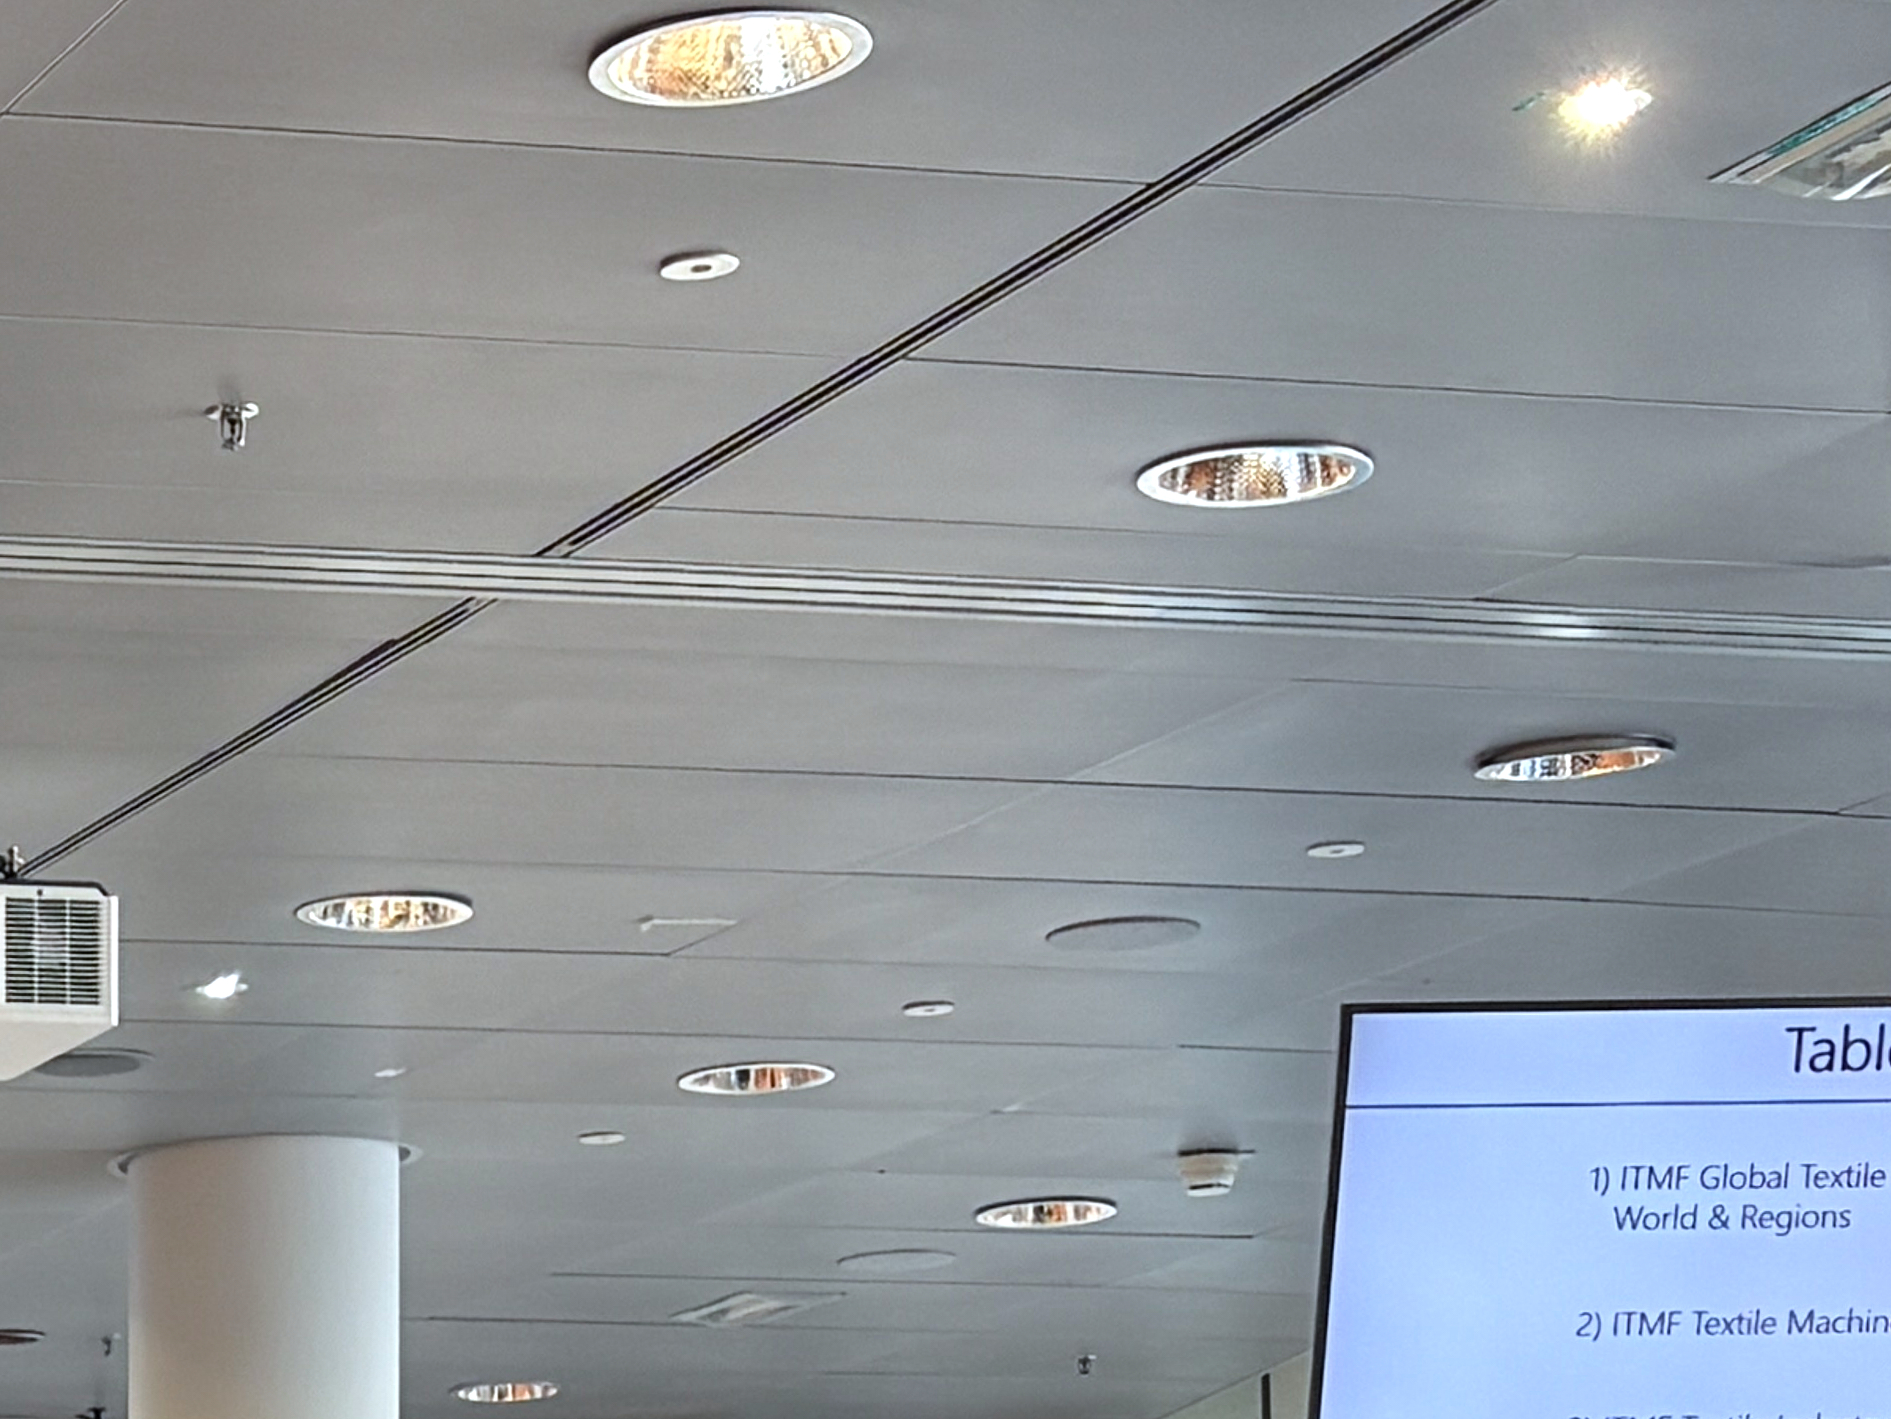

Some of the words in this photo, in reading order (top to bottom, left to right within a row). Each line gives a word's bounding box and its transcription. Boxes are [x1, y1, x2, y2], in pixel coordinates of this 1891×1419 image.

[1785, 1022, 1891, 1074] Tabl
[1590, 1166, 1610, 1197] 1)
[1620, 1164, 1690, 1191] ITMF
[1699, 1162, 1790, 1190] Global
[1801, 1161, 1887, 1190] Textile
[1613, 1203, 1699, 1231] World
[1707, 1204, 1730, 1231] &
[1740, 1204, 1851, 1237] Regions
[1575, 1311, 1602, 1342] 2)
[1612, 1310, 1683, 1337] ITMF
[1692, 1308, 1777, 1336] Textile
[1787, 1307, 1891, 1335] Machin
